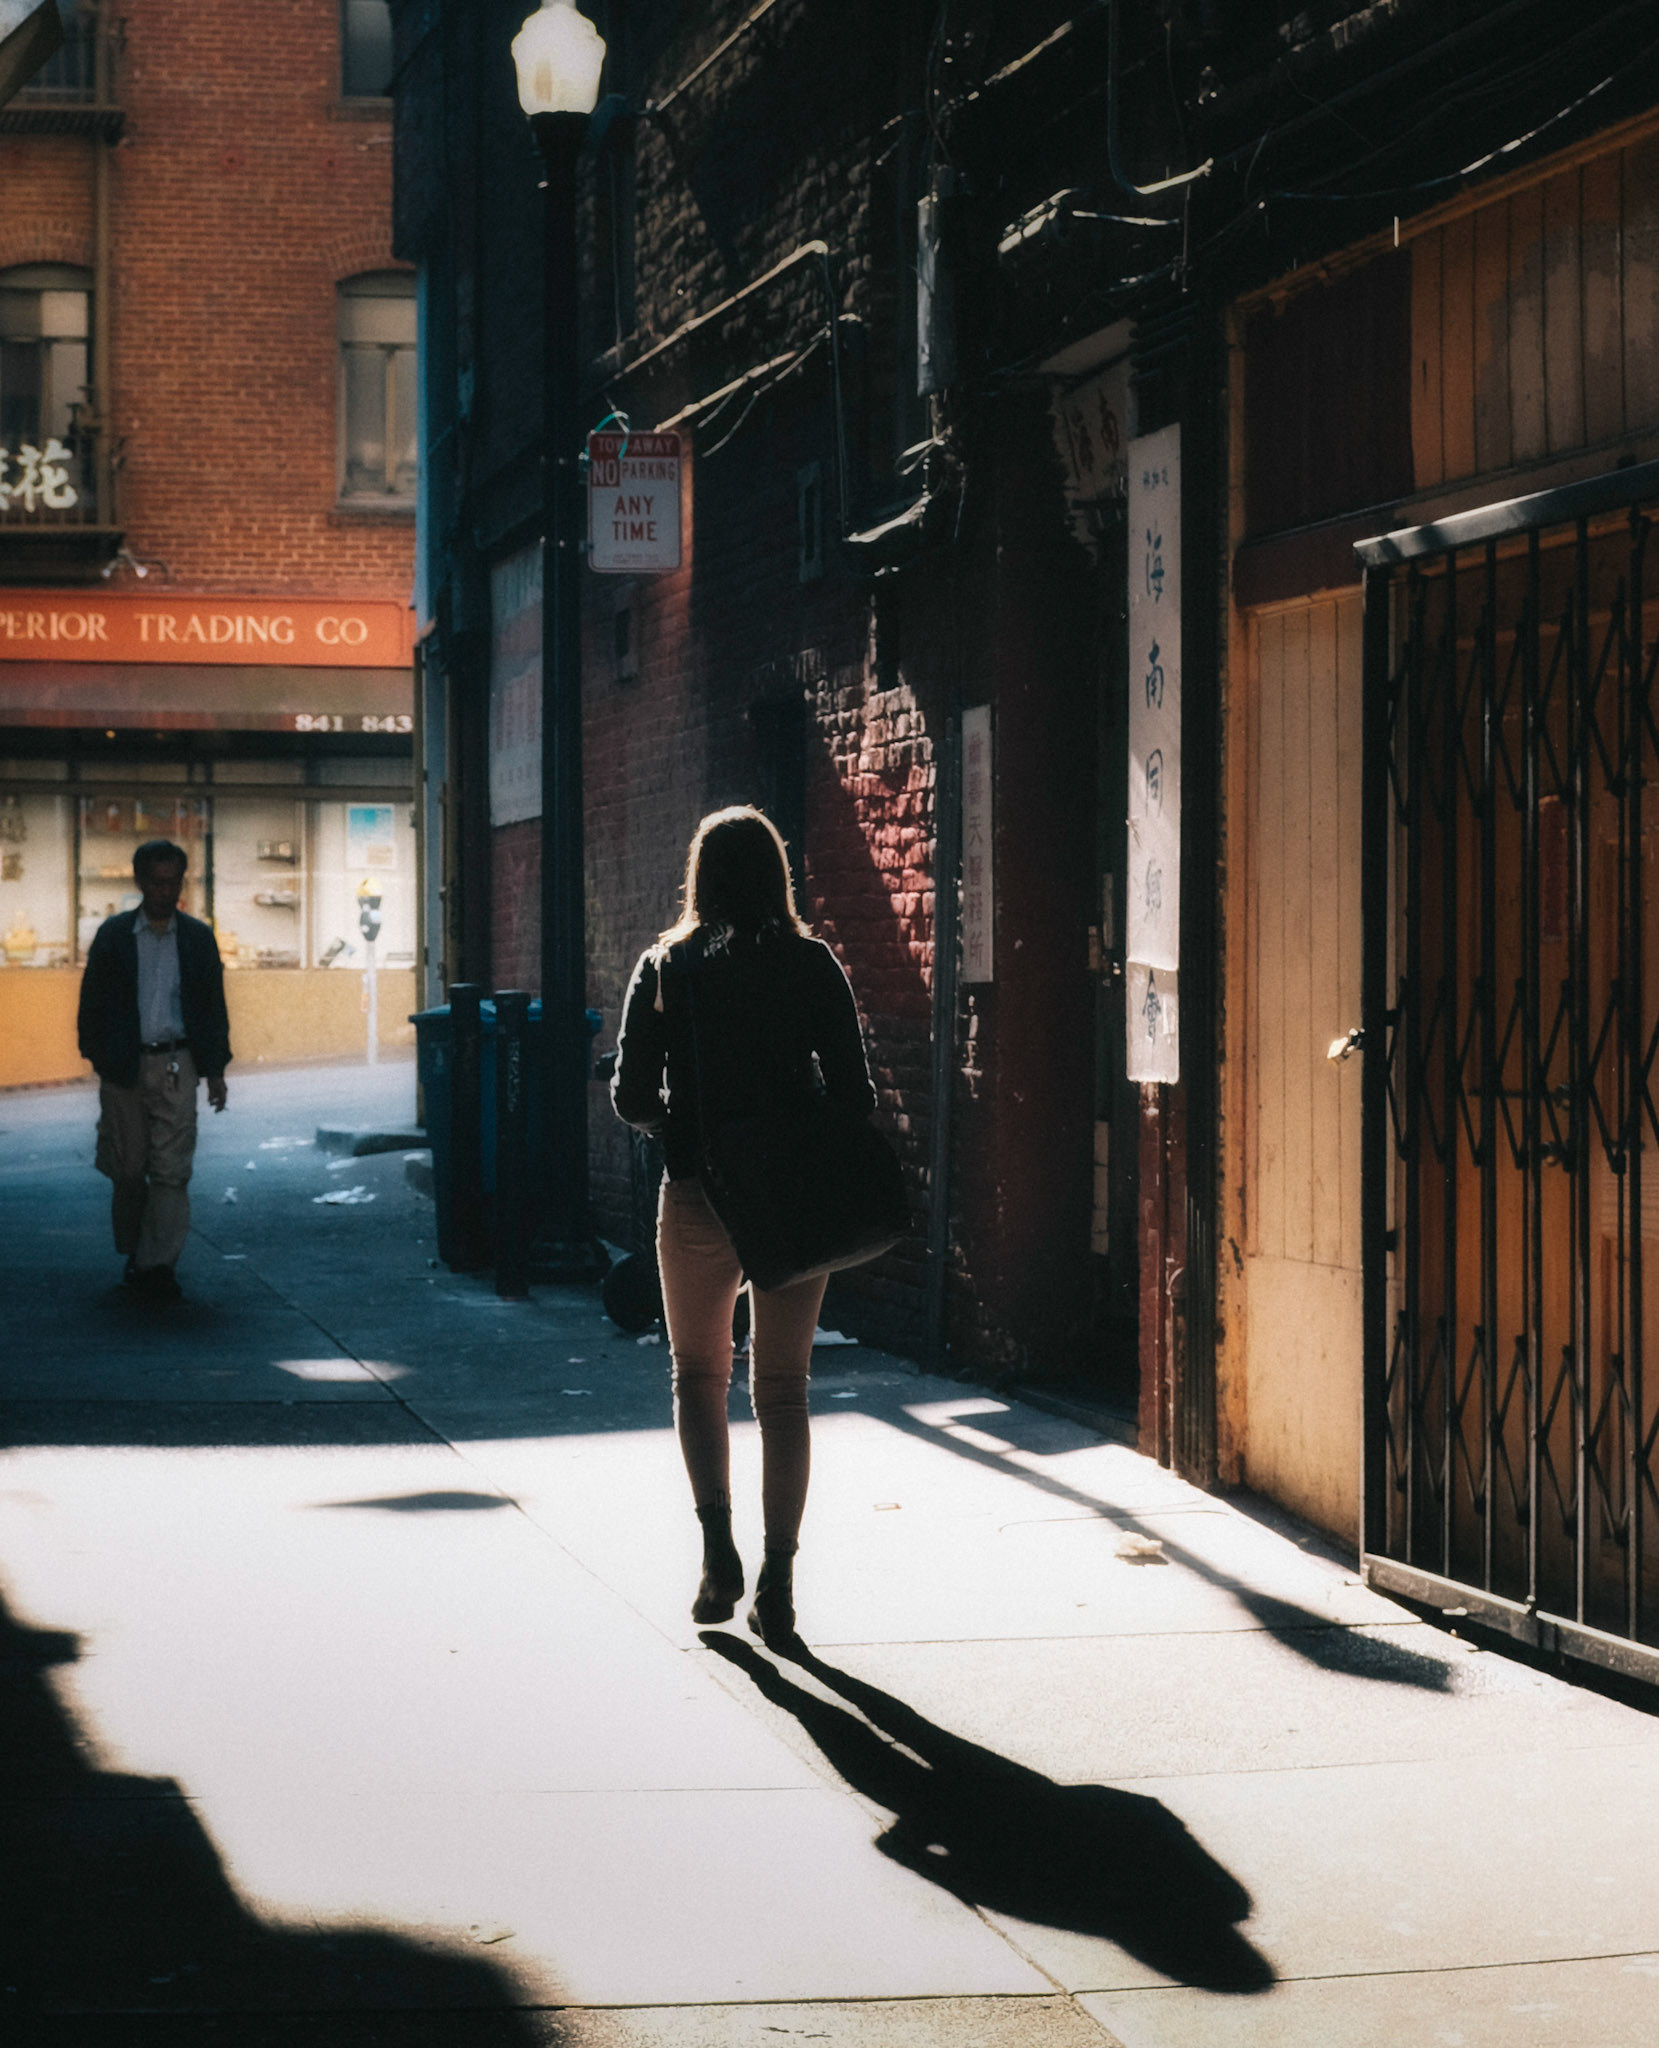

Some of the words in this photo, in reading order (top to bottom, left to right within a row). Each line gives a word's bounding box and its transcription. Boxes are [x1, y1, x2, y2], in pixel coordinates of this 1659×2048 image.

[592, 460, 617, 484] NO
[622, 462, 676, 481] PARKING
[614, 496, 654, 515] ANY
[612, 521, 657, 541] TIME
[134, 613, 295, 645] TRADING
[316, 616, 368, 646] CO
[295, 713, 344, 733] 841
[361, 715, 413, 733] 843
